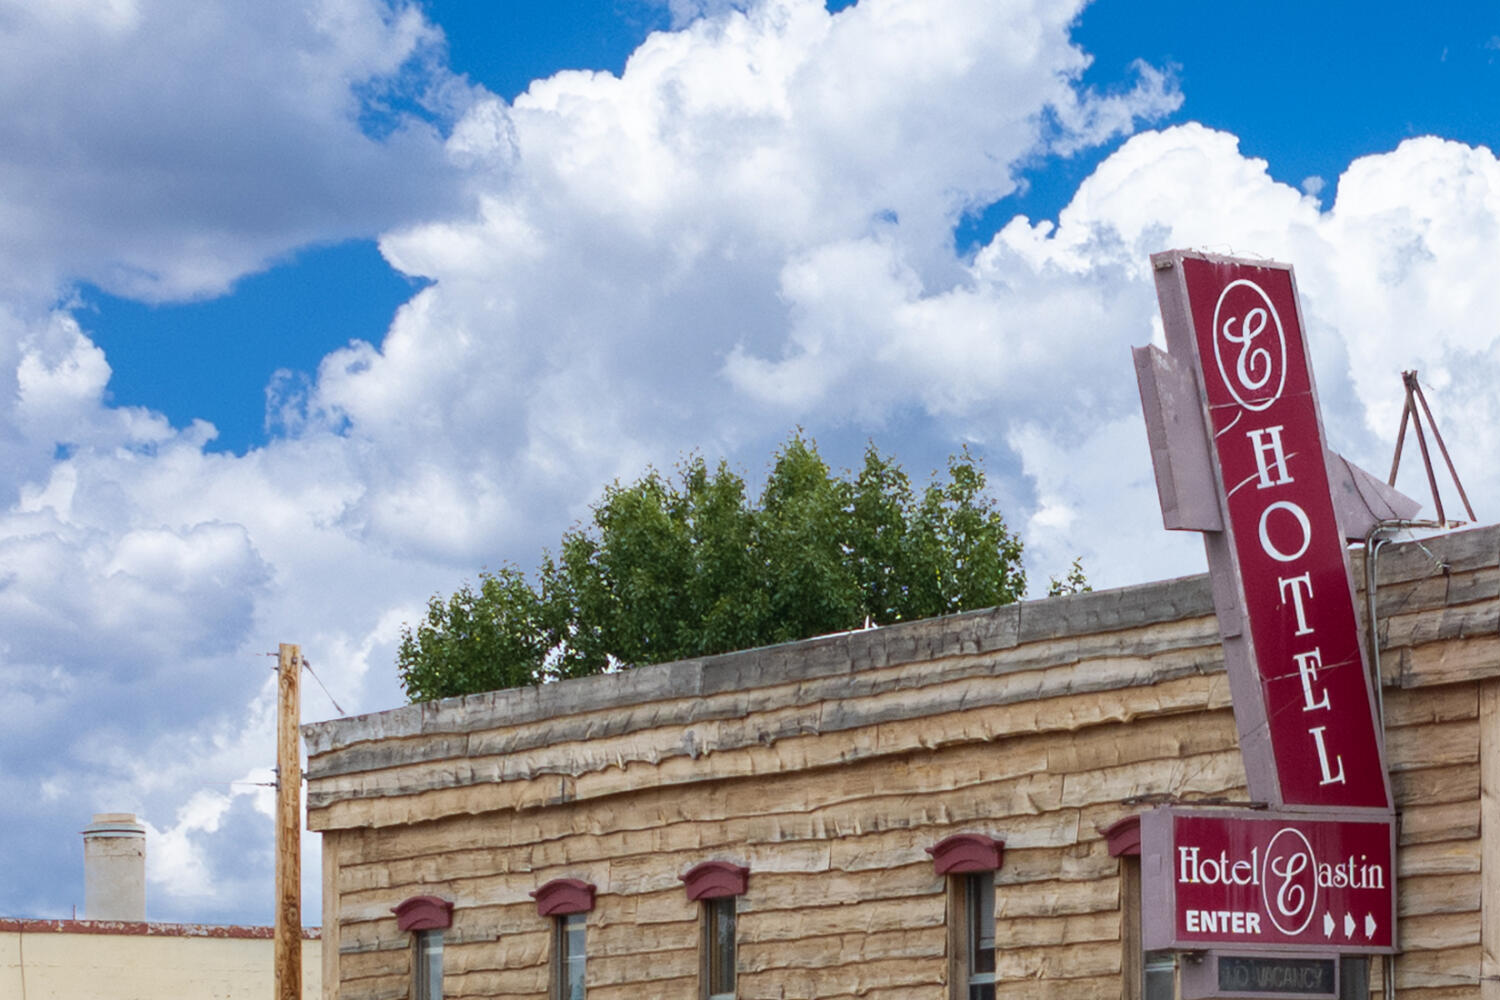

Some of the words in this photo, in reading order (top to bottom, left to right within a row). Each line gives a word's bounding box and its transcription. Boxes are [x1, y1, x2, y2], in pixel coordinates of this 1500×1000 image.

[1246, 425, 1346, 785] HOTEL
[1178, 846, 1260, 885] Hotel
[1272, 852, 1385, 916] Eastin
[1186, 910, 1261, 934] ENTER
[1256, 966, 1323, 989] VACANCY
